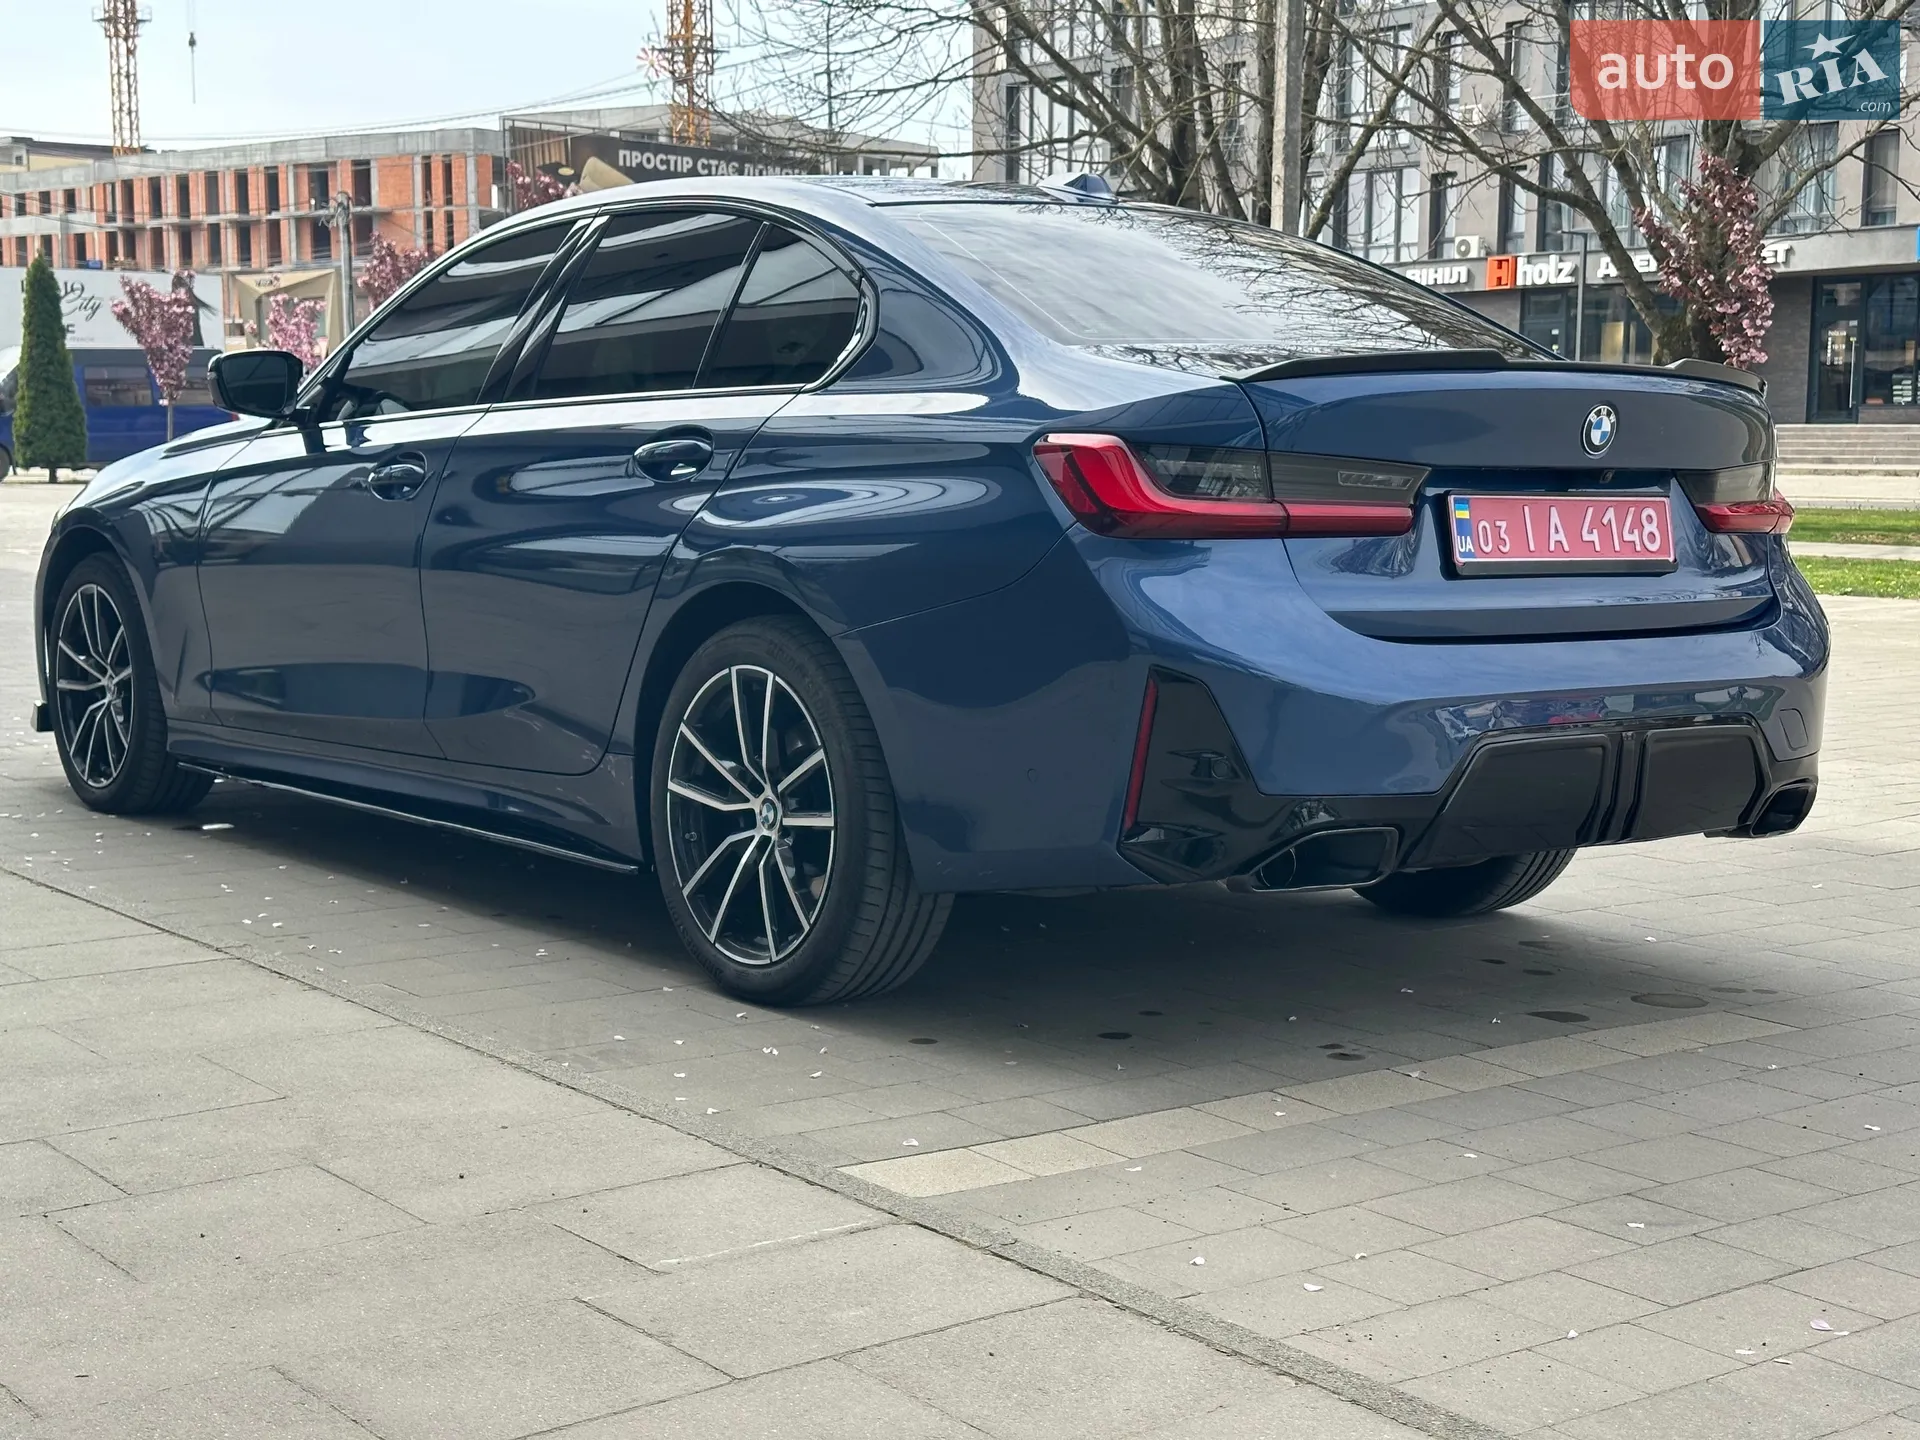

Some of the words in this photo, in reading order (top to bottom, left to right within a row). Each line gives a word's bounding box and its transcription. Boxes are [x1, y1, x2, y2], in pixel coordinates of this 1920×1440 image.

[618, 150, 693, 174] ПРОСТІР
[696, 159, 739, 176] СТАЄ
[1517, 254, 1575, 286] holz
[1457, 535, 1475, 553] UA
[1477, 519, 1511, 554] 03
[1581, 506, 1662, 553] 4148
